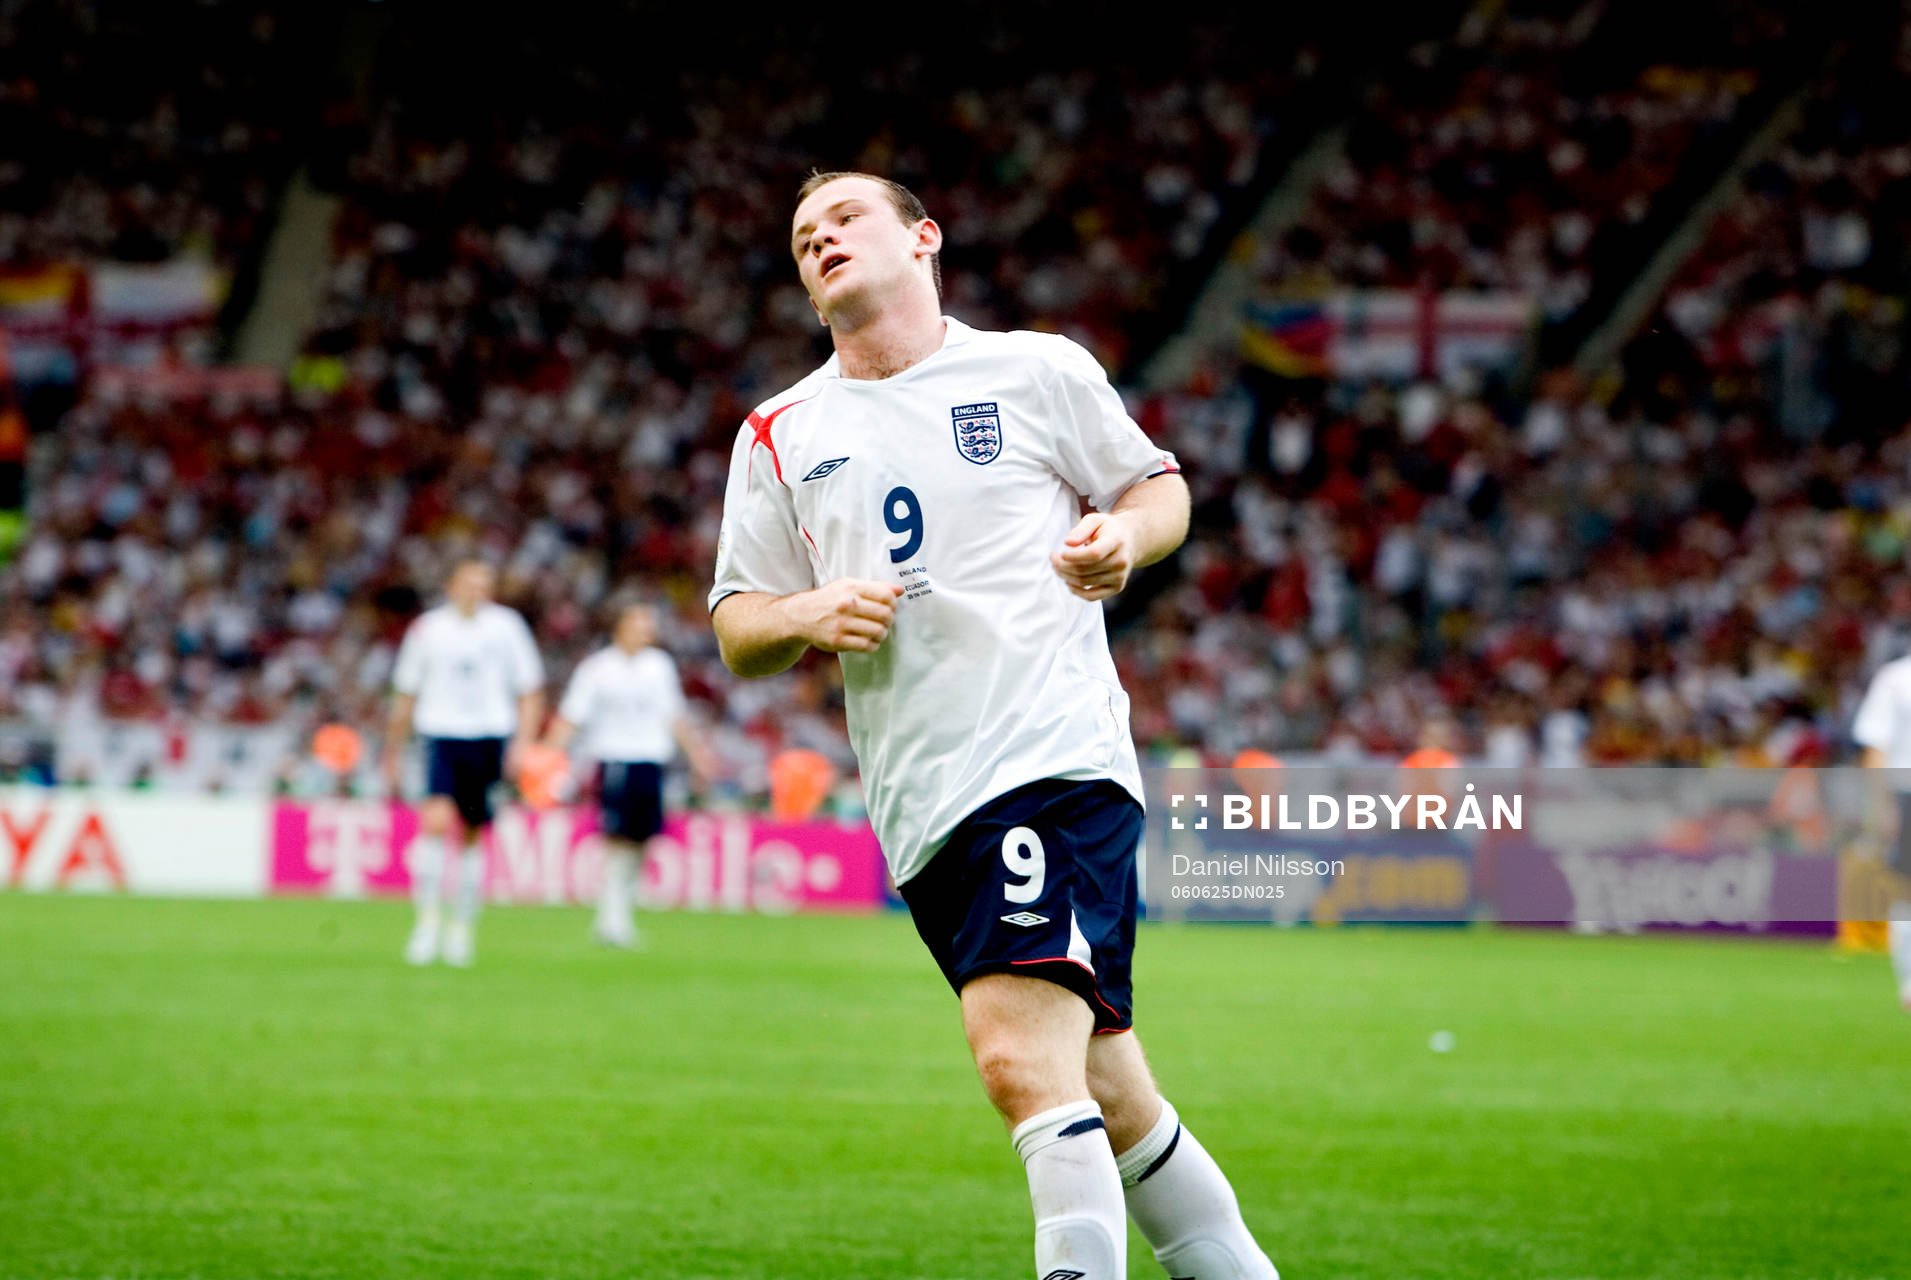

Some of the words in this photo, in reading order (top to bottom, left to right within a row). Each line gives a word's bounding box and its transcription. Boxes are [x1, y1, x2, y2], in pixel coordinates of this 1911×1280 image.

[953, 403, 996, 417] ENGLAND
[883, 486, 923, 563] 9
[898, 566, 928, 578] ENGLAND
[1001, 826, 1046, 904] 9
